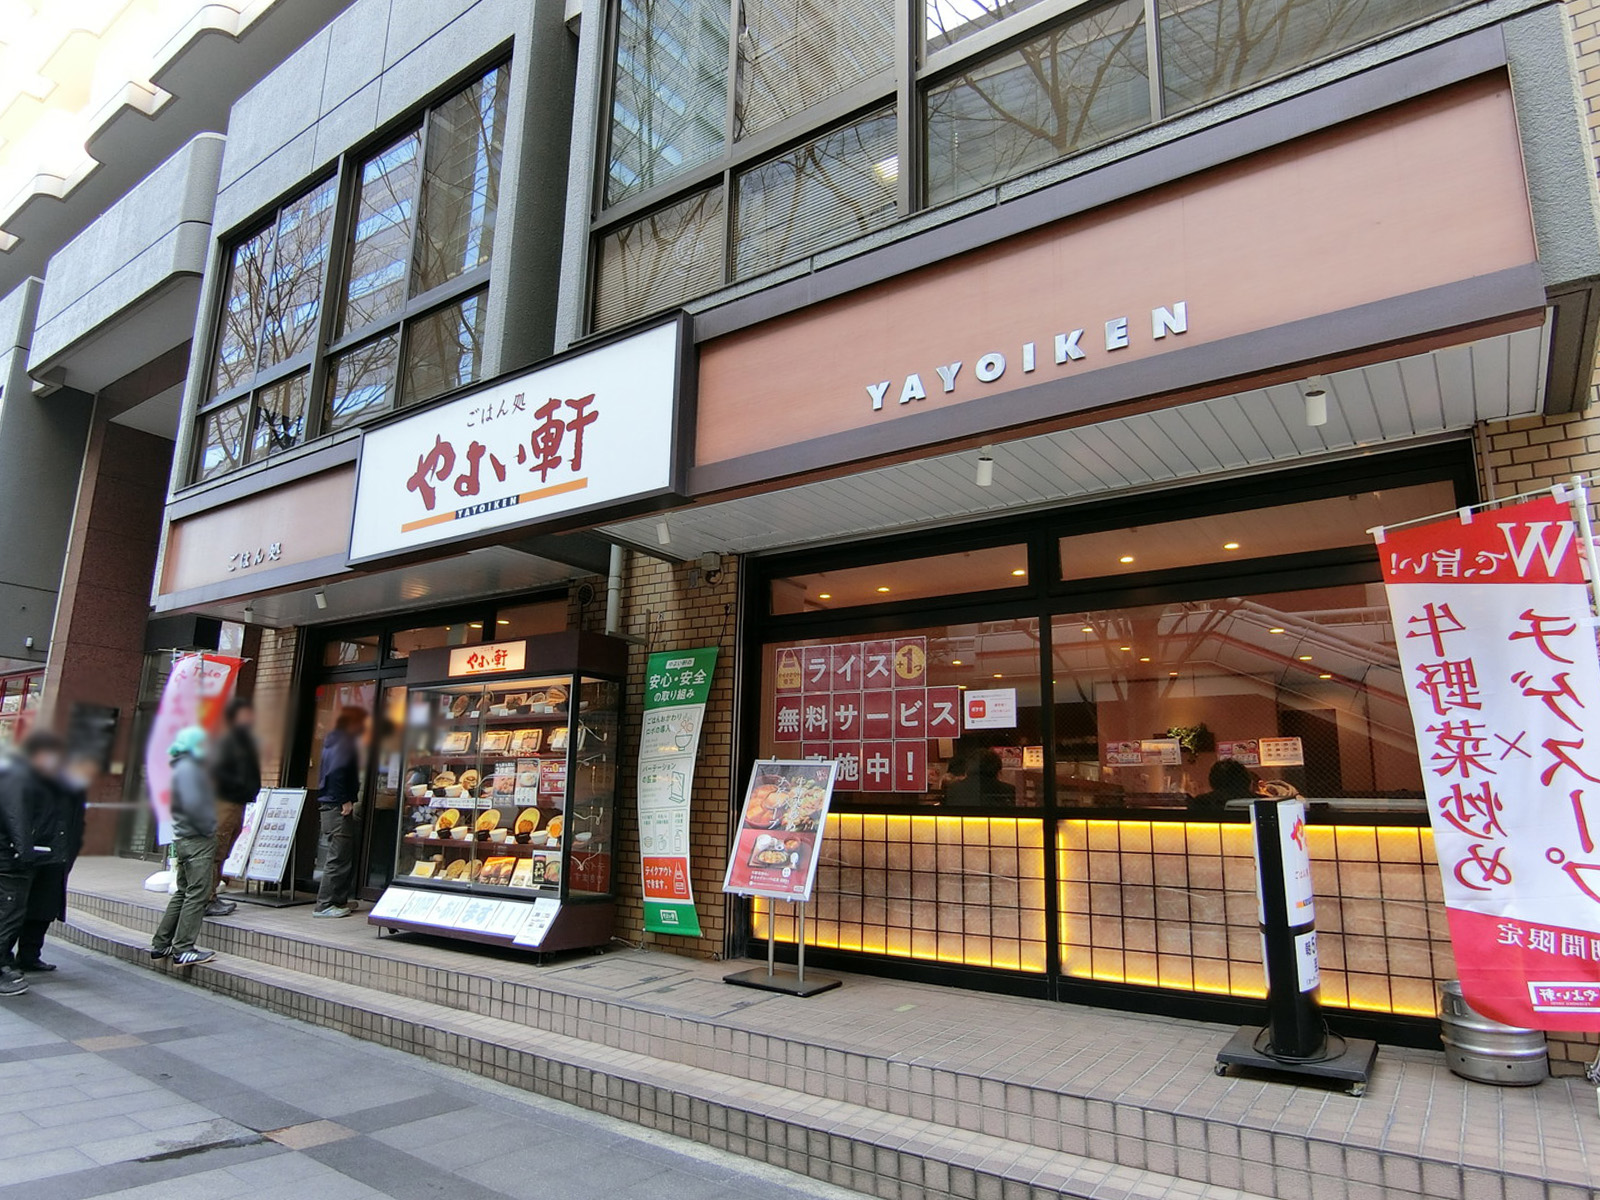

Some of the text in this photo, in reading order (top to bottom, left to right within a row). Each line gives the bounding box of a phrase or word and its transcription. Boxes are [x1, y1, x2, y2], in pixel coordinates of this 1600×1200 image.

[866, 301, 1188, 411] YAYOIKEN
[467, 392, 525, 427] ごはん処
[406, 394, 600, 511] やよい軒
[458, 496, 517, 518] YAYOIKEN
[228, 542, 282, 572] ごはん処
[467, 649, 508, 669] やよい軒
[808, 654, 890, 684] ライス
[649, 669, 707, 690] 安心・安全
[653, 688, 695, 702] の取り組み
[777, 699, 956, 733] 無料サービス
[805, 752, 914, 783] 施中!
[645, 865, 672, 876] テイクアウト
